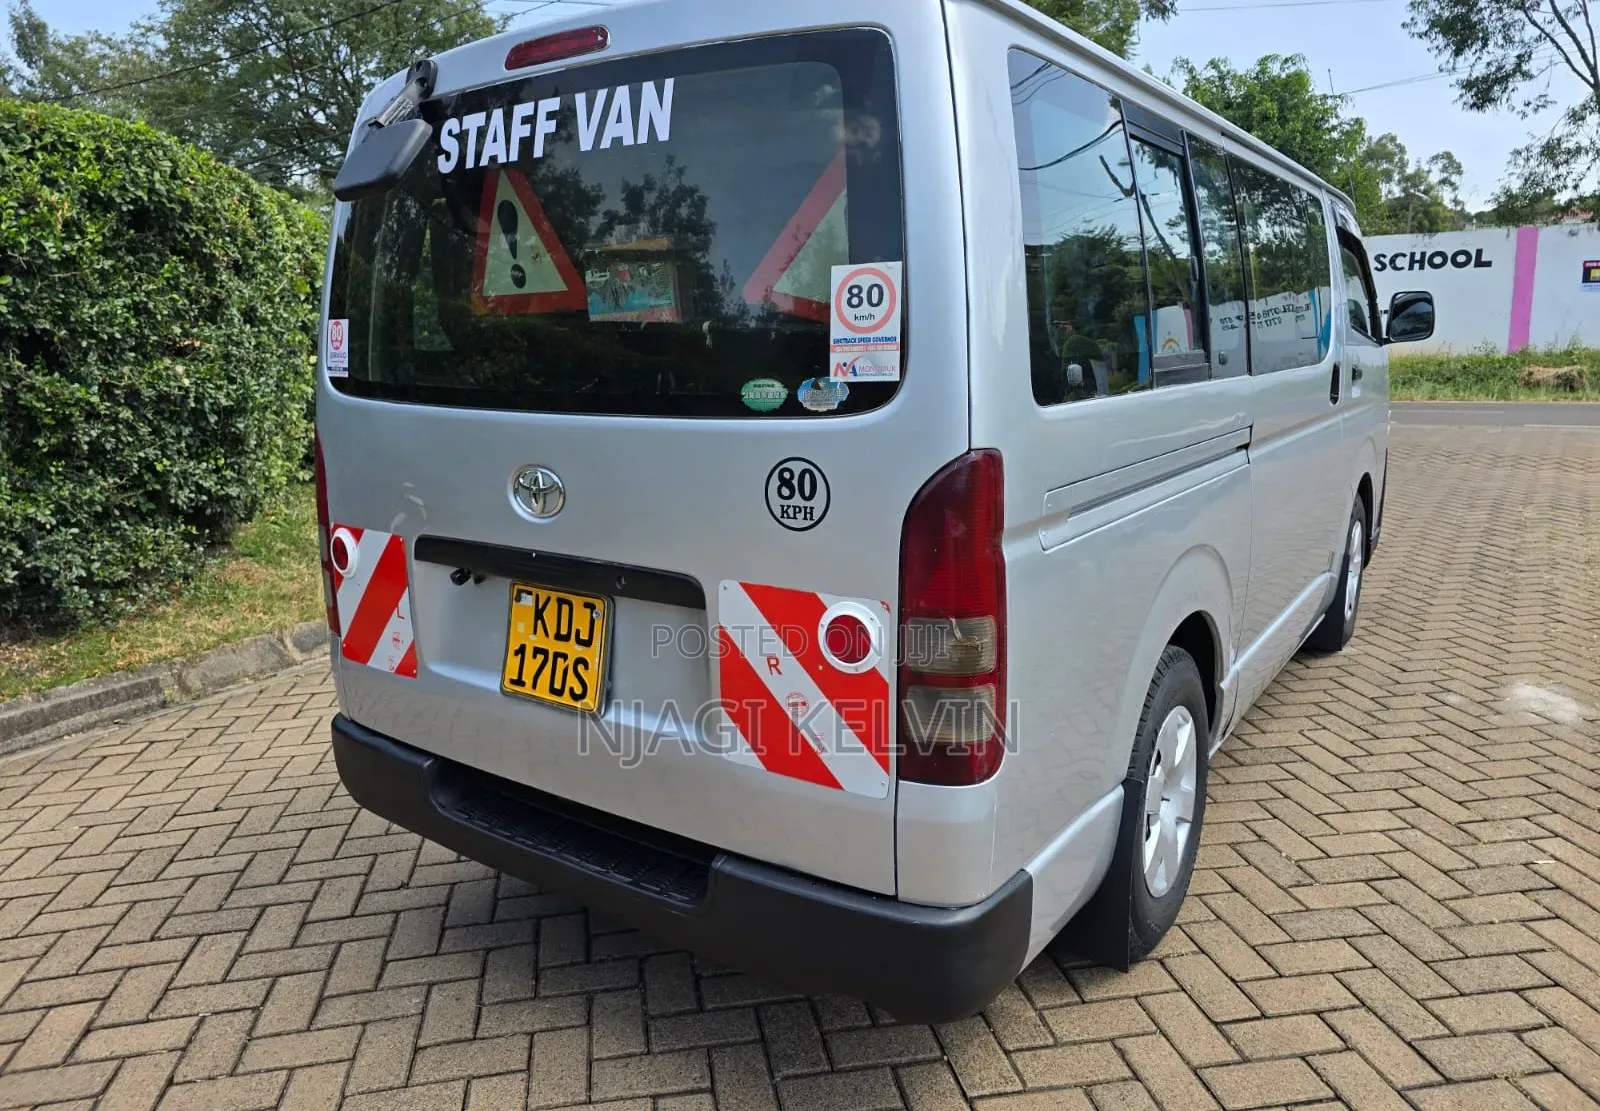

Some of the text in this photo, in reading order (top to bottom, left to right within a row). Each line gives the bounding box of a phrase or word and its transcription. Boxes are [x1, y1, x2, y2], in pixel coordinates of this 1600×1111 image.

[437, 77, 675, 174] STAFF VAN
[1374, 248, 1493, 272] SCHOOL
[846, 283, 884, 309] 80
[854, 313, 876, 322] km/h
[331, 325, 343, 341] 80
[872, 335, 897, 343] GOVERNOR
[777, 467, 817, 502] 80
[780, 504, 815, 521] KPH
[533, 593, 597, 648] KDJ
[509, 643, 590, 702] 170S
[767, 656, 783, 676] R
